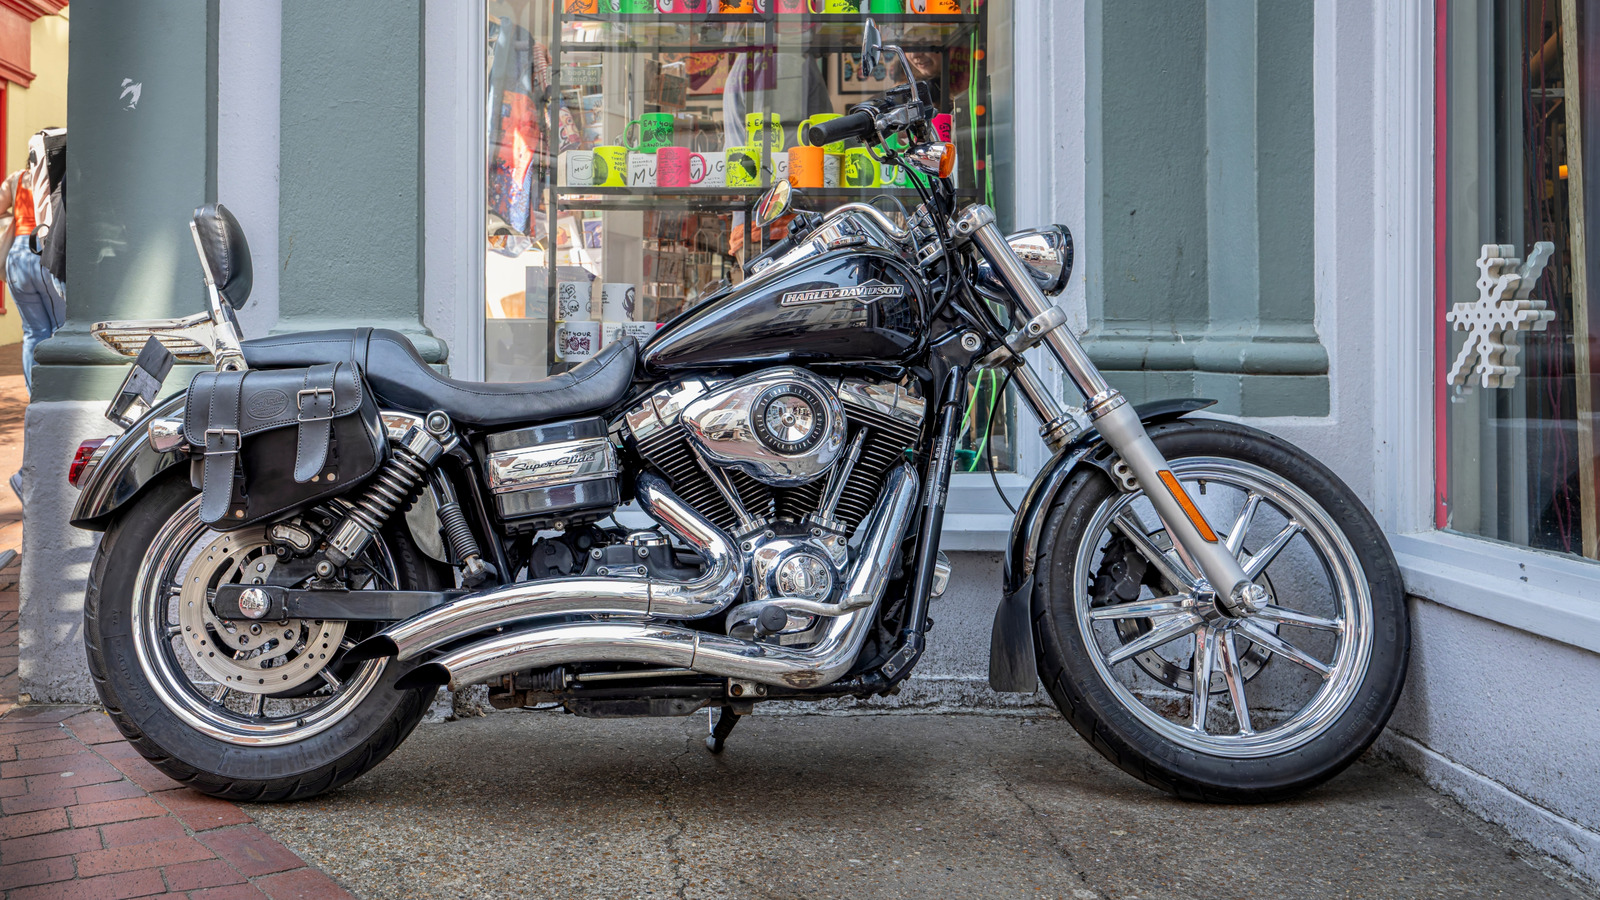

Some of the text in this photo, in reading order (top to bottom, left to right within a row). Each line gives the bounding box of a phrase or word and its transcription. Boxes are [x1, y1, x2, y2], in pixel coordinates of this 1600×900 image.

[643, 119, 658, 128] EAT
[574, 164, 589, 174] MUG
[632, 167, 657, 186] MU
[786, 286, 902, 303] HARLEY-DAVIDSON
